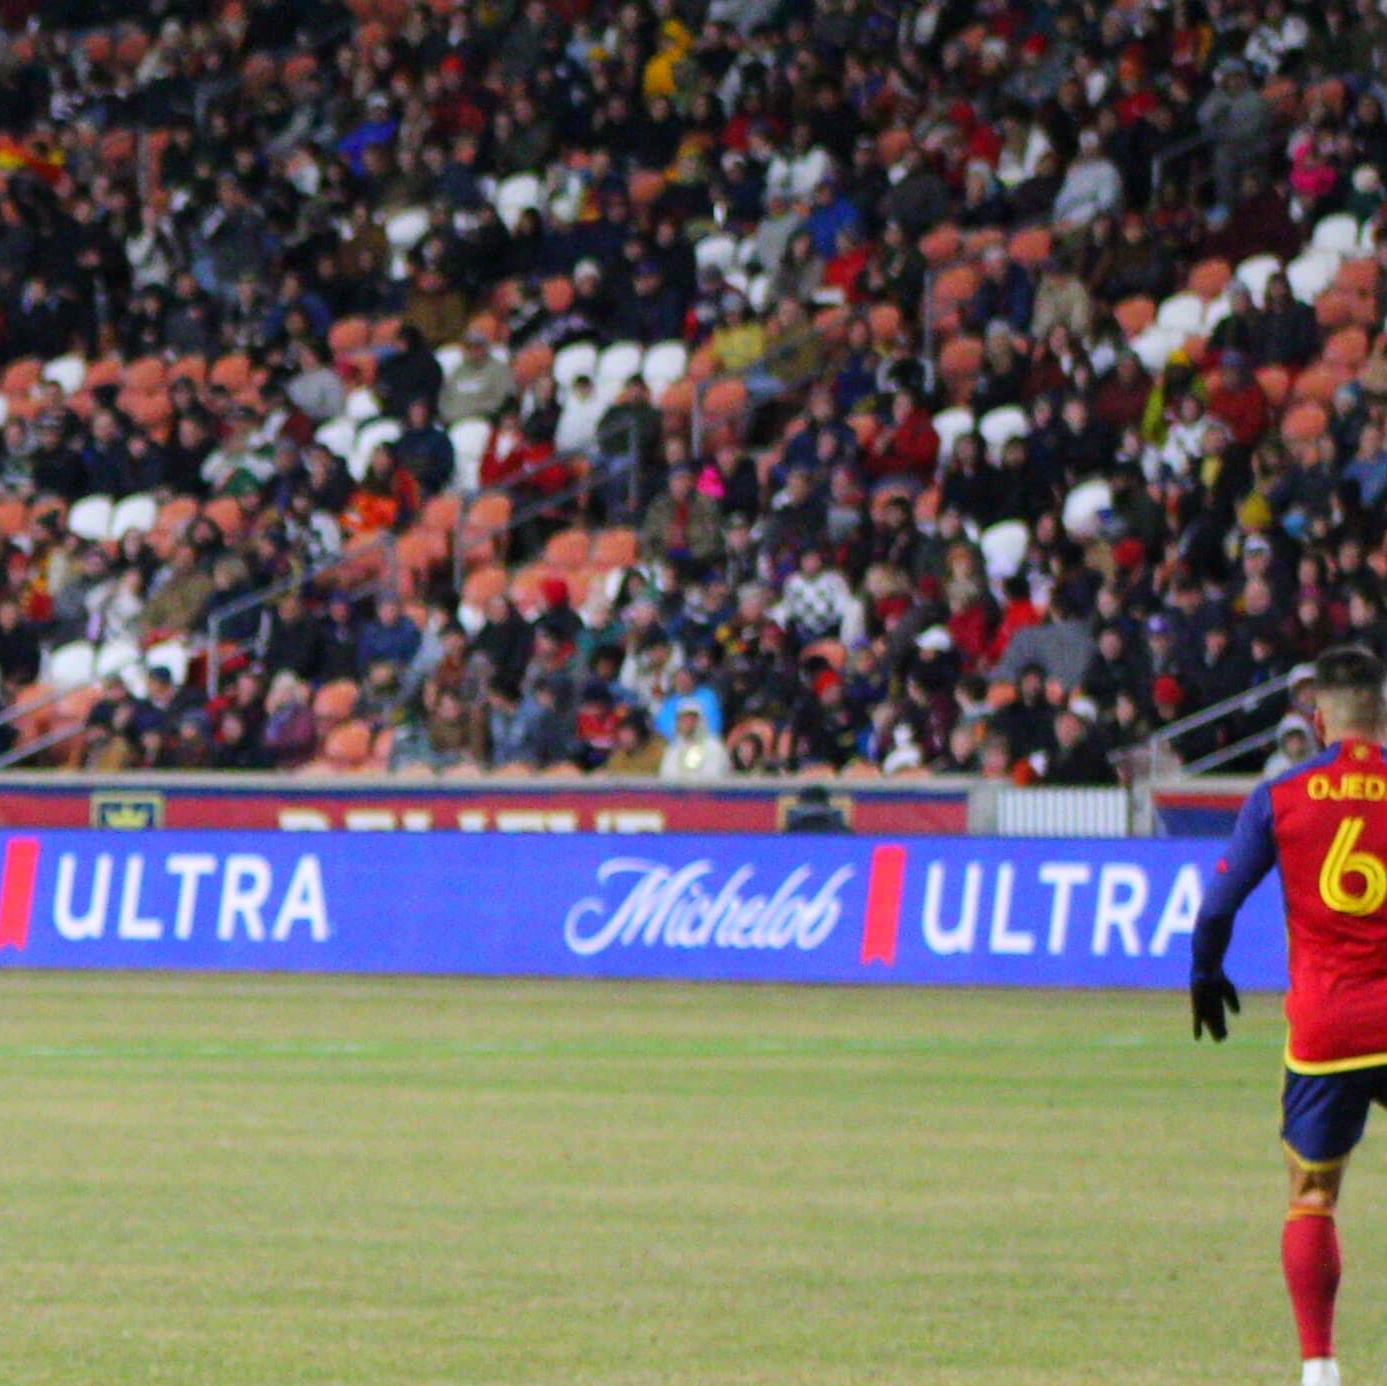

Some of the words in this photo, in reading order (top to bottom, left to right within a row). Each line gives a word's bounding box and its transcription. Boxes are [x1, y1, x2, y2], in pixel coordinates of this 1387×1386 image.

[1307, 773, 1387, 800] OJED
[51, 852, 331, 942] ULTRA
[564, 856, 855, 956] Michelob
[921, 860, 1203, 957] ULTRA
[1319, 816, 1387, 916] 6
